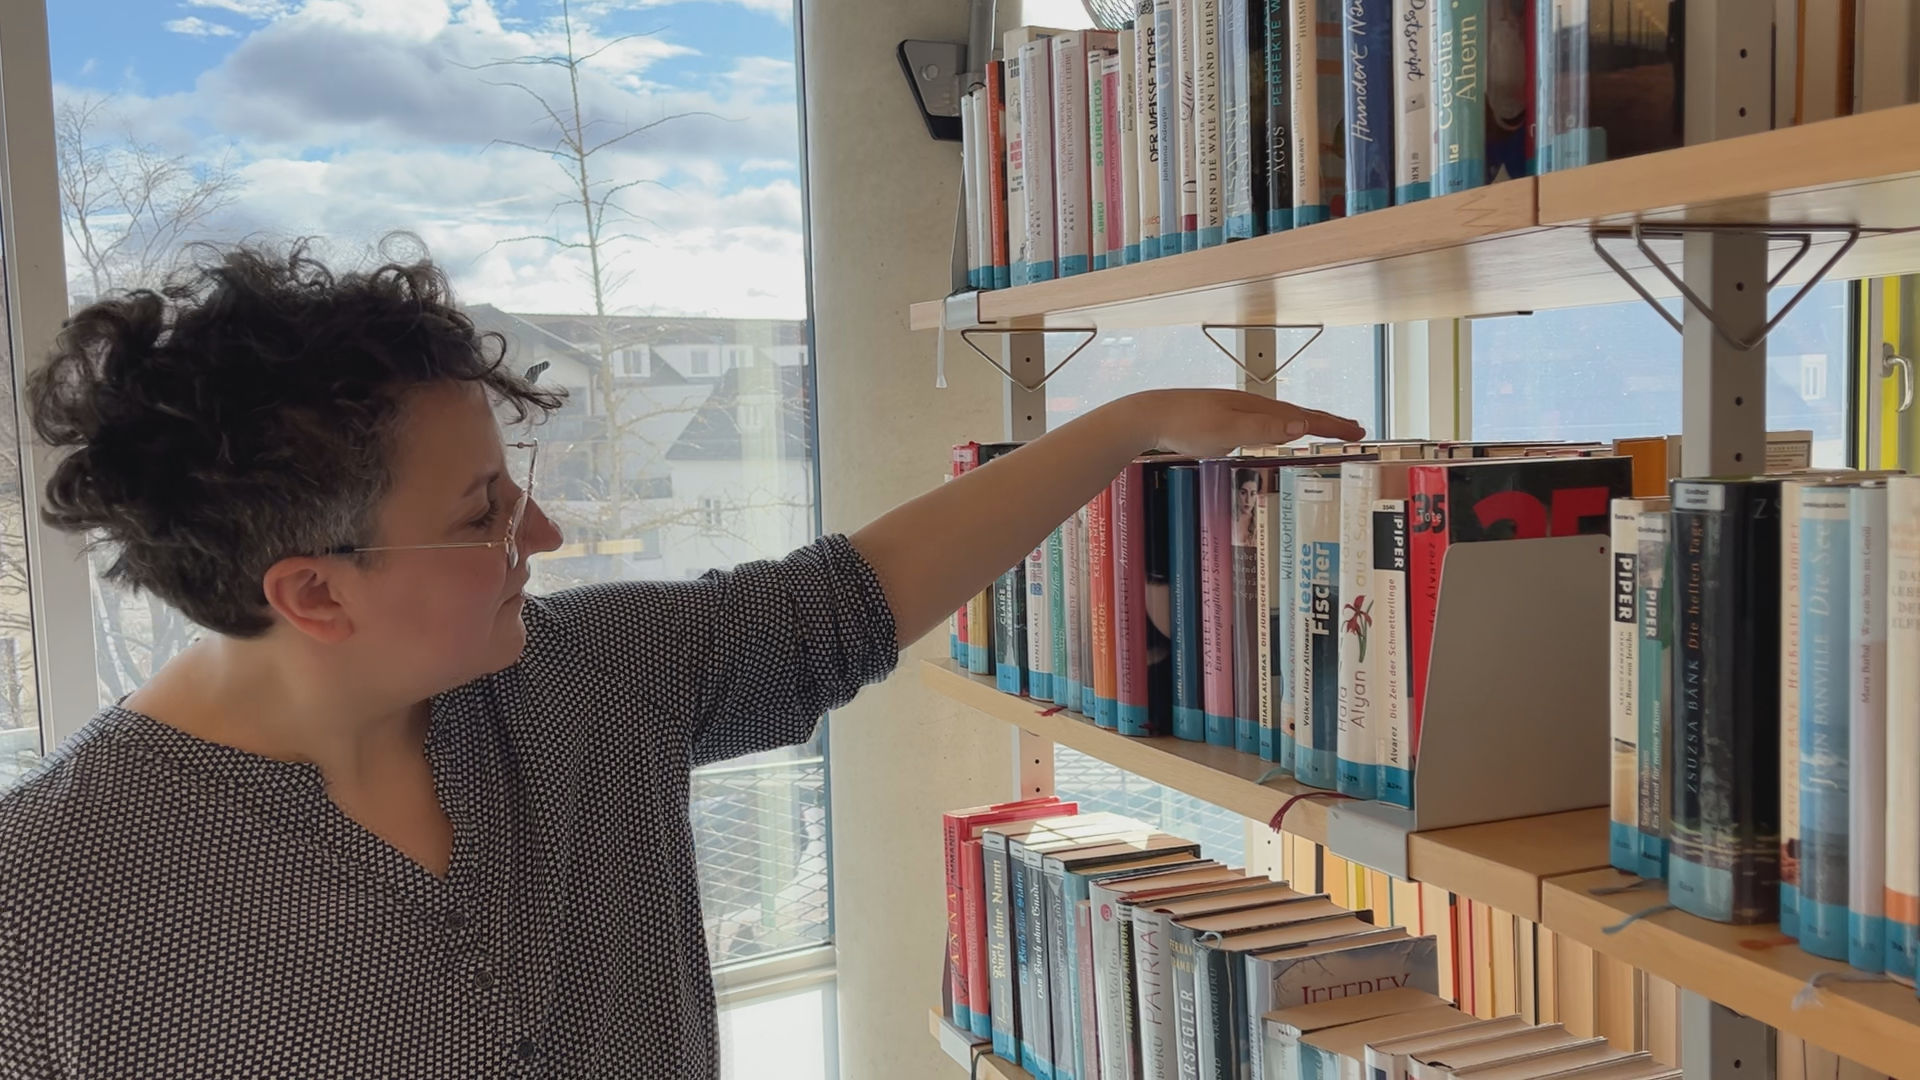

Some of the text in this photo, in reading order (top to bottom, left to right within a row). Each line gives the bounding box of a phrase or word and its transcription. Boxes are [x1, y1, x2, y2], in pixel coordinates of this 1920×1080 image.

[1064, 53, 1072, 80] LIEBE
[1157, 20, 1171, 89] CIAO
[1271, 20, 1282, 106] PERFEKTE
[1294, 42, 1303, 91] DIE VOM
[1437, 28, 1454, 130] Cecelia
[1454, 14, 1478, 104] Ahern
[1146, 27, 1159, 162] DER WEISSE TIGER
[1180, 70, 1194, 121] Liebe
[1205, 0, 1218, 226] WENN DIE WALE AN LAND GEHEN
[1350, 43, 1374, 143] Hundert
[1093, 79, 1106, 234] ABREU SO FURCHTLOS
[1198, 122, 1206, 165] Kathrin
[1272, 126, 1286, 175] AGUS
[1281, 491, 1293, 581] WILLKOMMEN
[1353, 487, 1369, 542] Sand
[1381, 503, 1396, 511] 3540
[1411, 493, 1446, 533] 35
[1098, 517, 1108, 557] NAMEN
[1258, 523, 1266, 582] SOUFFLEUSE
[1393, 519, 1405, 569] PIPER
[1788, 521, 1800, 592] Sommer
[1808, 524, 1831, 567] See
[1861, 559, 1871, 571] im
[1068, 570, 1076, 586] Der
[1116, 467, 1132, 695] ISABEL ALLENDE Amandas Suche
[1312, 542, 1330, 636] Fischer
[1354, 550, 1368, 588] aus
[1618, 557, 1634, 618] PIPER
[1807, 569, 1831, 618] Die
[1861, 573, 1872, 597] Stein
[999, 588, 1007, 626] CLAIRE
[1005, 579, 1014, 638] ALEXANDER
[1098, 601, 1107, 654] ALLENDE
[1201, 526, 1212, 677] ISABEL ALLENDE
[1210, 535, 1223, 673] Ein unvergänglicher Sommer
[1259, 584, 1267, 630] JÜDISCHE
[1645, 588, 1658, 638] PIPER
[1861, 599, 1872, 615] ein
[1861, 617, 1872, 636] Wie
[1299, 543, 1311, 727] Volker Harry Altwasser letzte
[1685, 517, 1704, 794] ZSUZSA BÁNK Die hellen Tage
[1860, 643, 1871, 673] Barbal
[1351, 670, 1370, 729] Alyan
[1386, 578, 1399, 764] Alvarez Die Zeit der Schmetterlinge
[1624, 631, 1635, 716] Die Rose von Jericho
[1809, 635, 1829, 725] BANVILLE
[1861, 674, 1872, 704] Maria
[1338, 686, 1348, 733] Hala
[1640, 750, 1651, 828] Sergio Bambaren
[1649, 700, 1661, 829] Ein Strand für meine Träume
[948, 825, 956, 880] AMMANITI
[947, 892, 960, 966] ANNA
[991, 858, 1007, 979] Buch ohne Namen
[1030, 881, 1044, 999] Das Buch ohne Gnade
[1017, 935, 1028, 963] Buch
[1139, 930, 1162, 1026] PATRIA
[1122, 978, 1134, 1034] FERNANDO
[1209, 966, 1220, 1041] ARAMBURU
[1153, 1036, 1165, 1080] BURU
